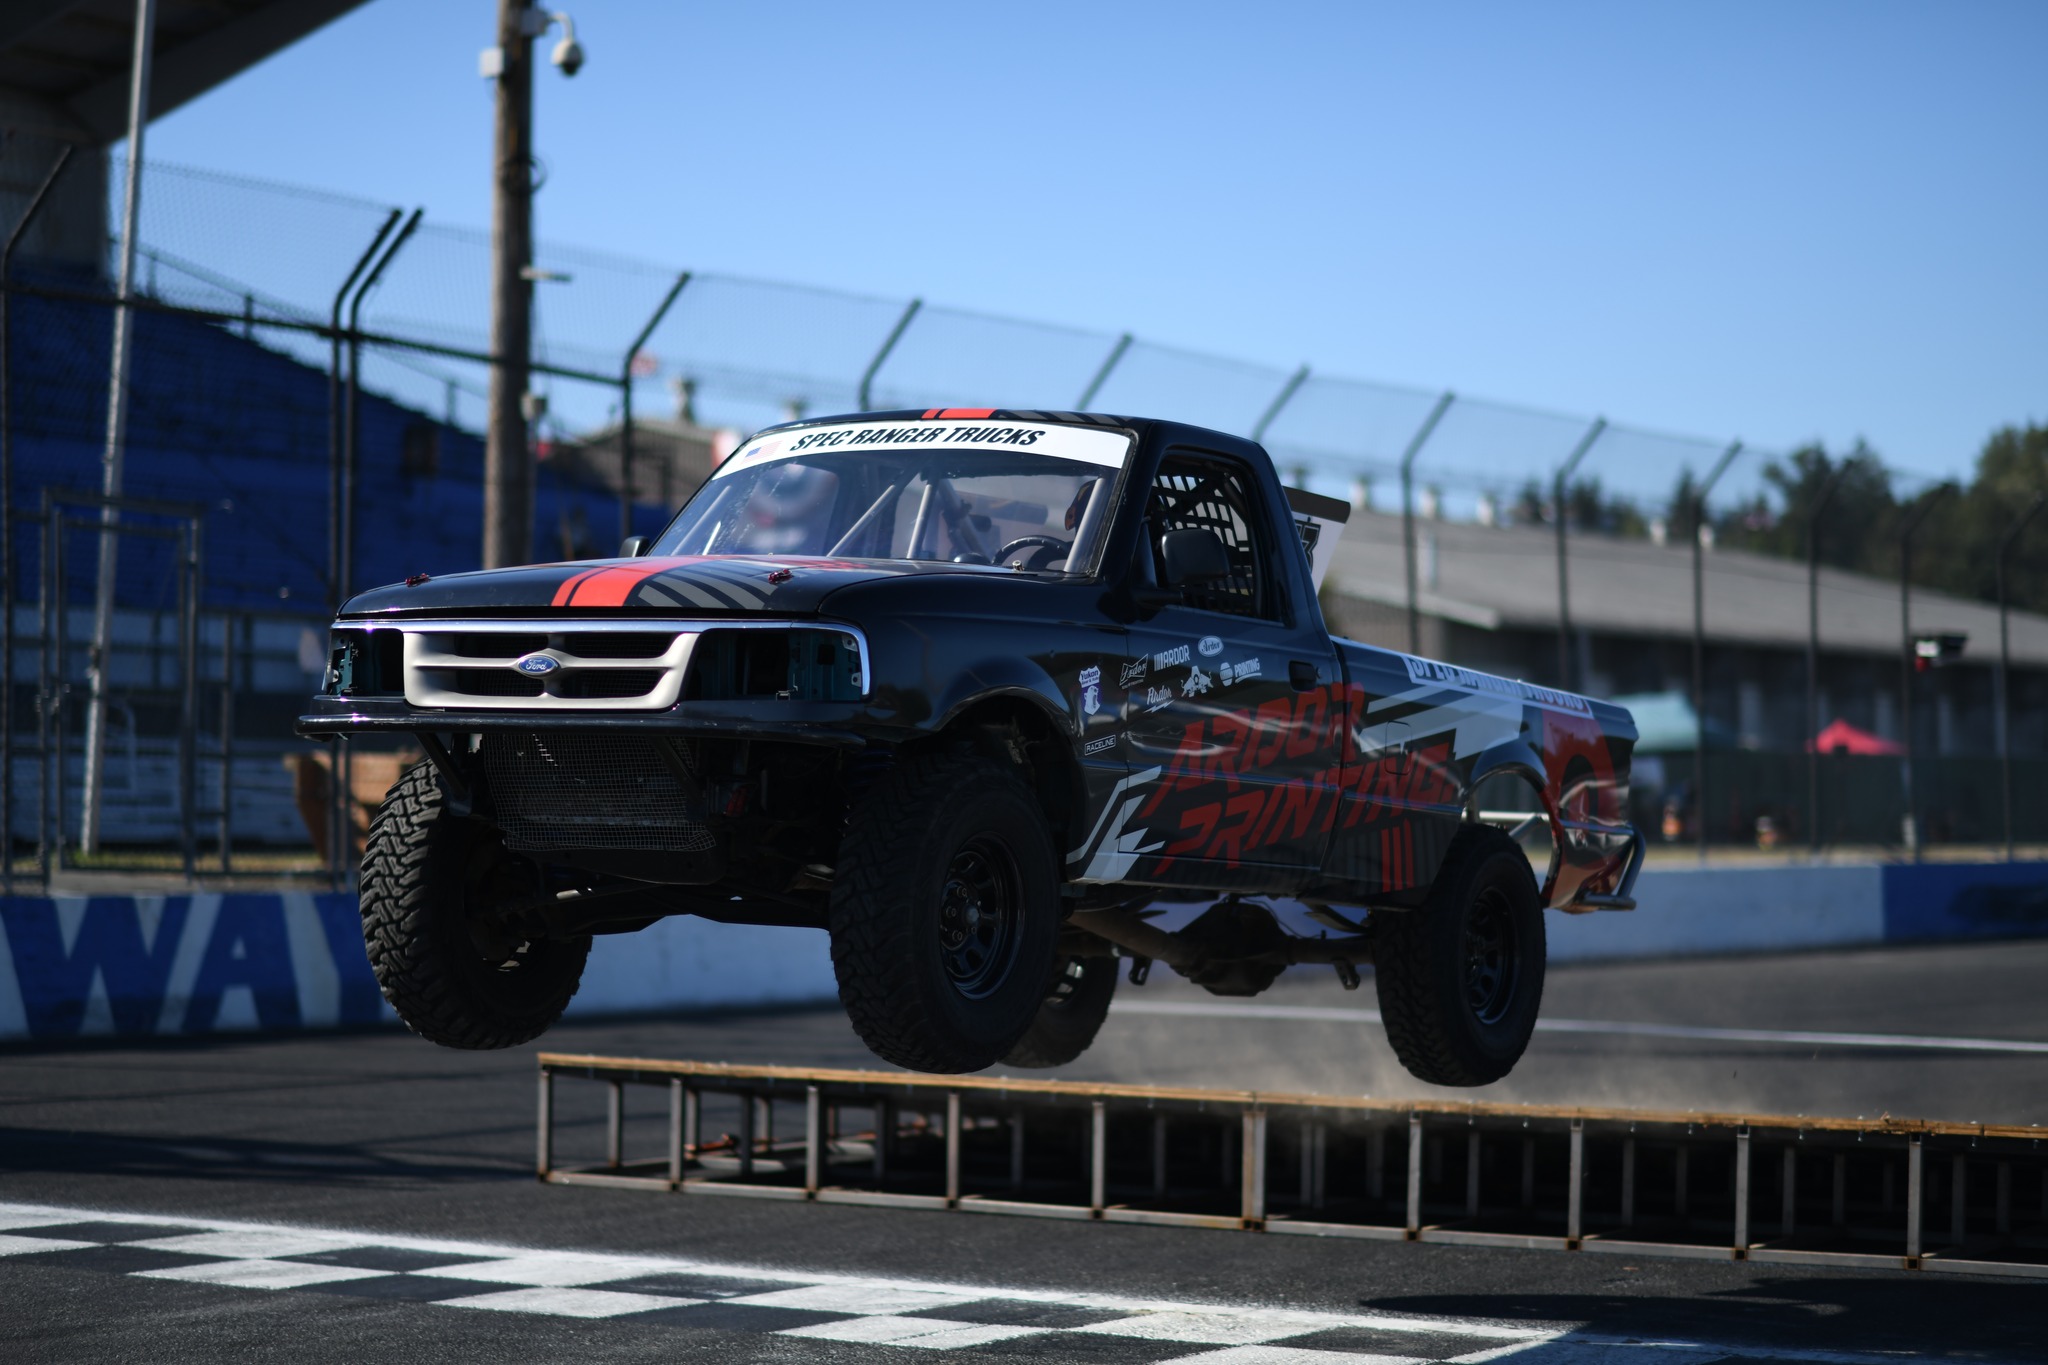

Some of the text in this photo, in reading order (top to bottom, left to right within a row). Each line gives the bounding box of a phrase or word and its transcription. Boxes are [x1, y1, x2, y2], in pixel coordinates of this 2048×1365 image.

[790, 426, 1047, 451] SPEC RANGER TRUCKS
[526, 658, 549, 672] Ford
[1162, 645, 1190, 668] ARDOR
[1234, 657, 1261, 678] PRINTING
[1081, 668, 1099, 681] Yukon
[1086, 738, 1115, 752] RACELINE
[1140, 682, 1365, 819] ARDOR
[1153, 743, 1455, 877] PRINTING
